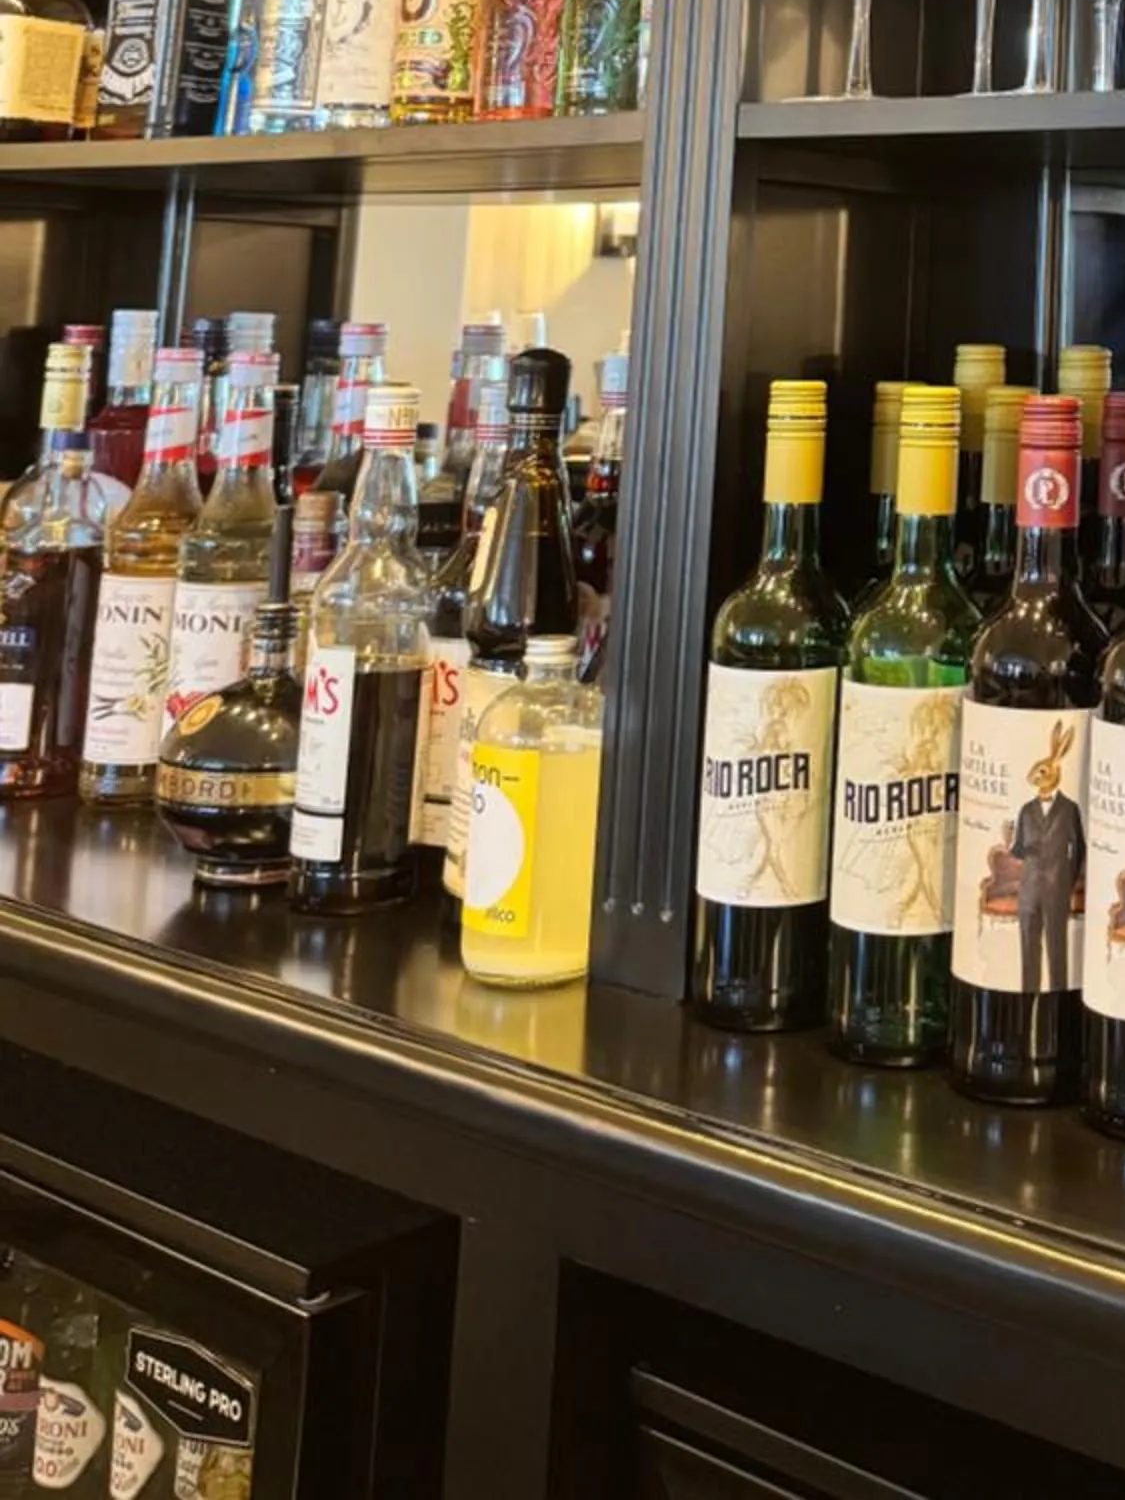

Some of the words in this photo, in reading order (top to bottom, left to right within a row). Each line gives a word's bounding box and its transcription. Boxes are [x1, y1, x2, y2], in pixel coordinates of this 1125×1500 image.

[736, 752, 810, 798] ROCA
[844, 779, 879, 823] RIO
[886, 772, 959, 821] ROCA
[135, 1351, 207, 1404] STERLING
[208, 1387, 243, 1422] PRO
